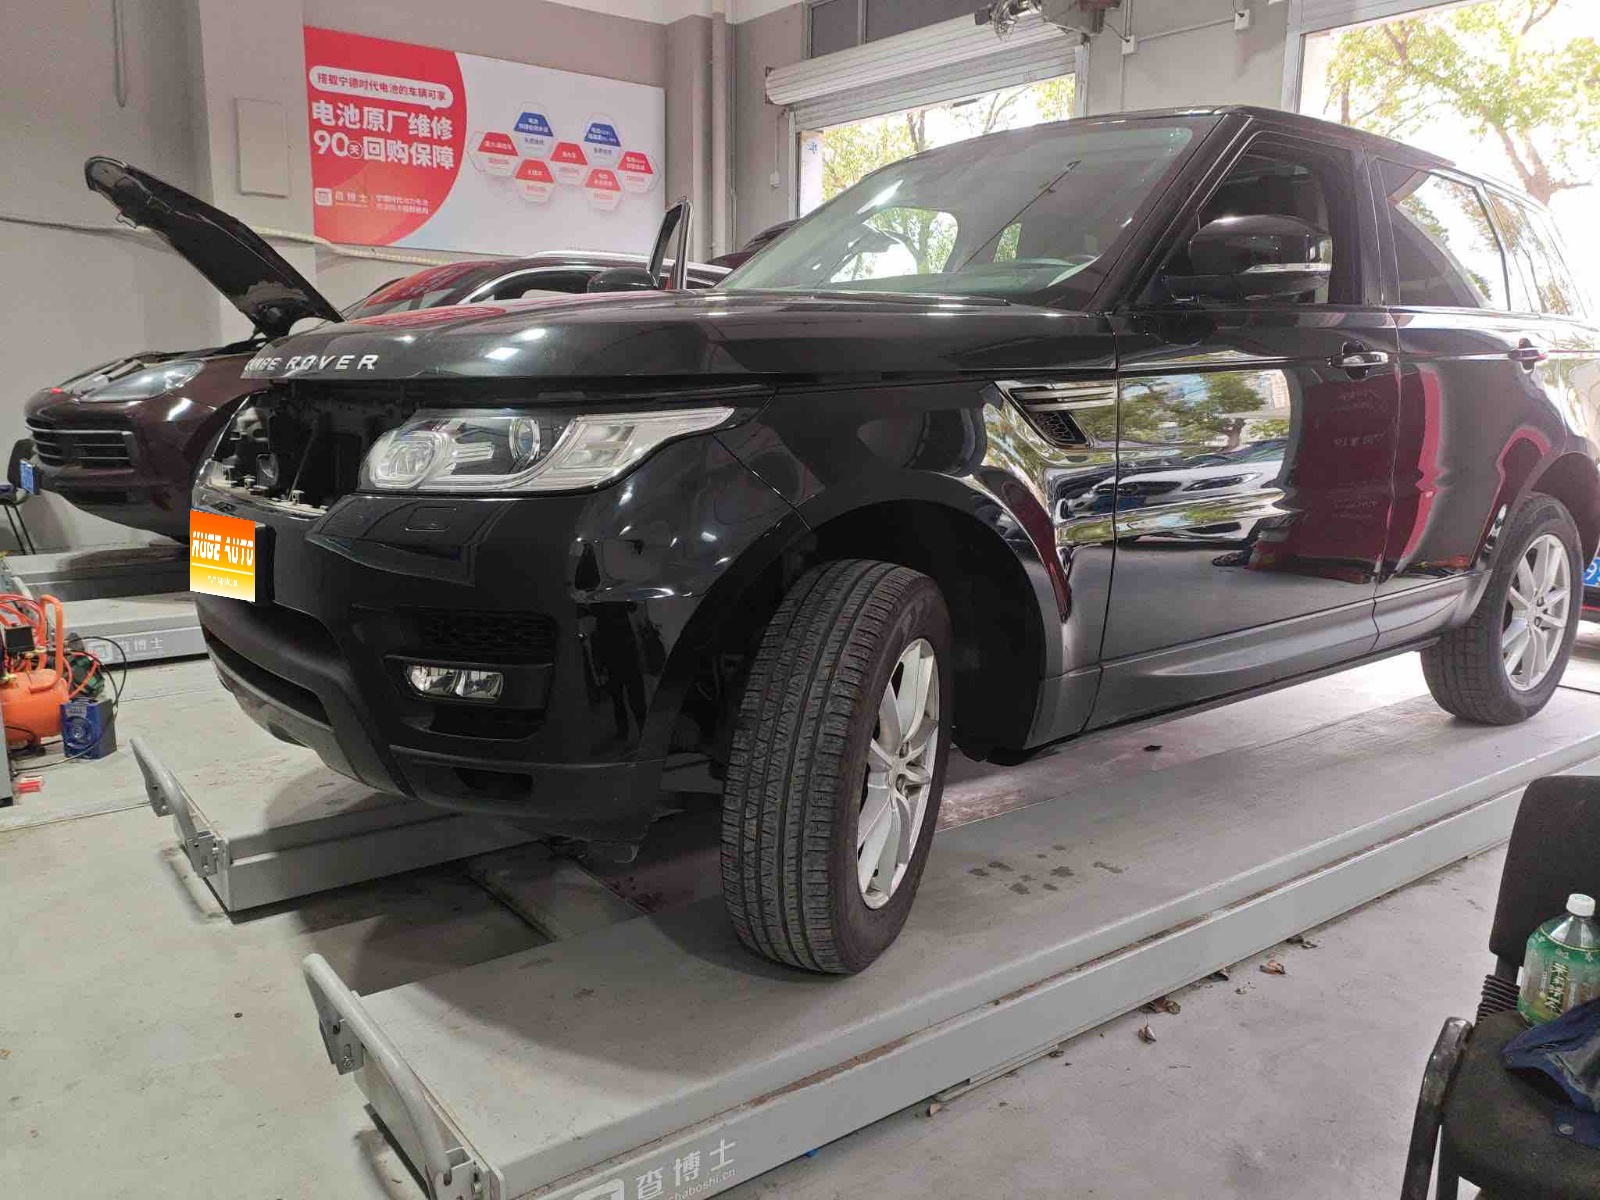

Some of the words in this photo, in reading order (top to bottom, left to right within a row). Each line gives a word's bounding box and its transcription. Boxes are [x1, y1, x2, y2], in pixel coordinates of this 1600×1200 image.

[311, 100, 452, 140] 电池原厂维修
[284, 355, 379, 370] ROVER
[635, 1139, 737, 1200] 查博士
